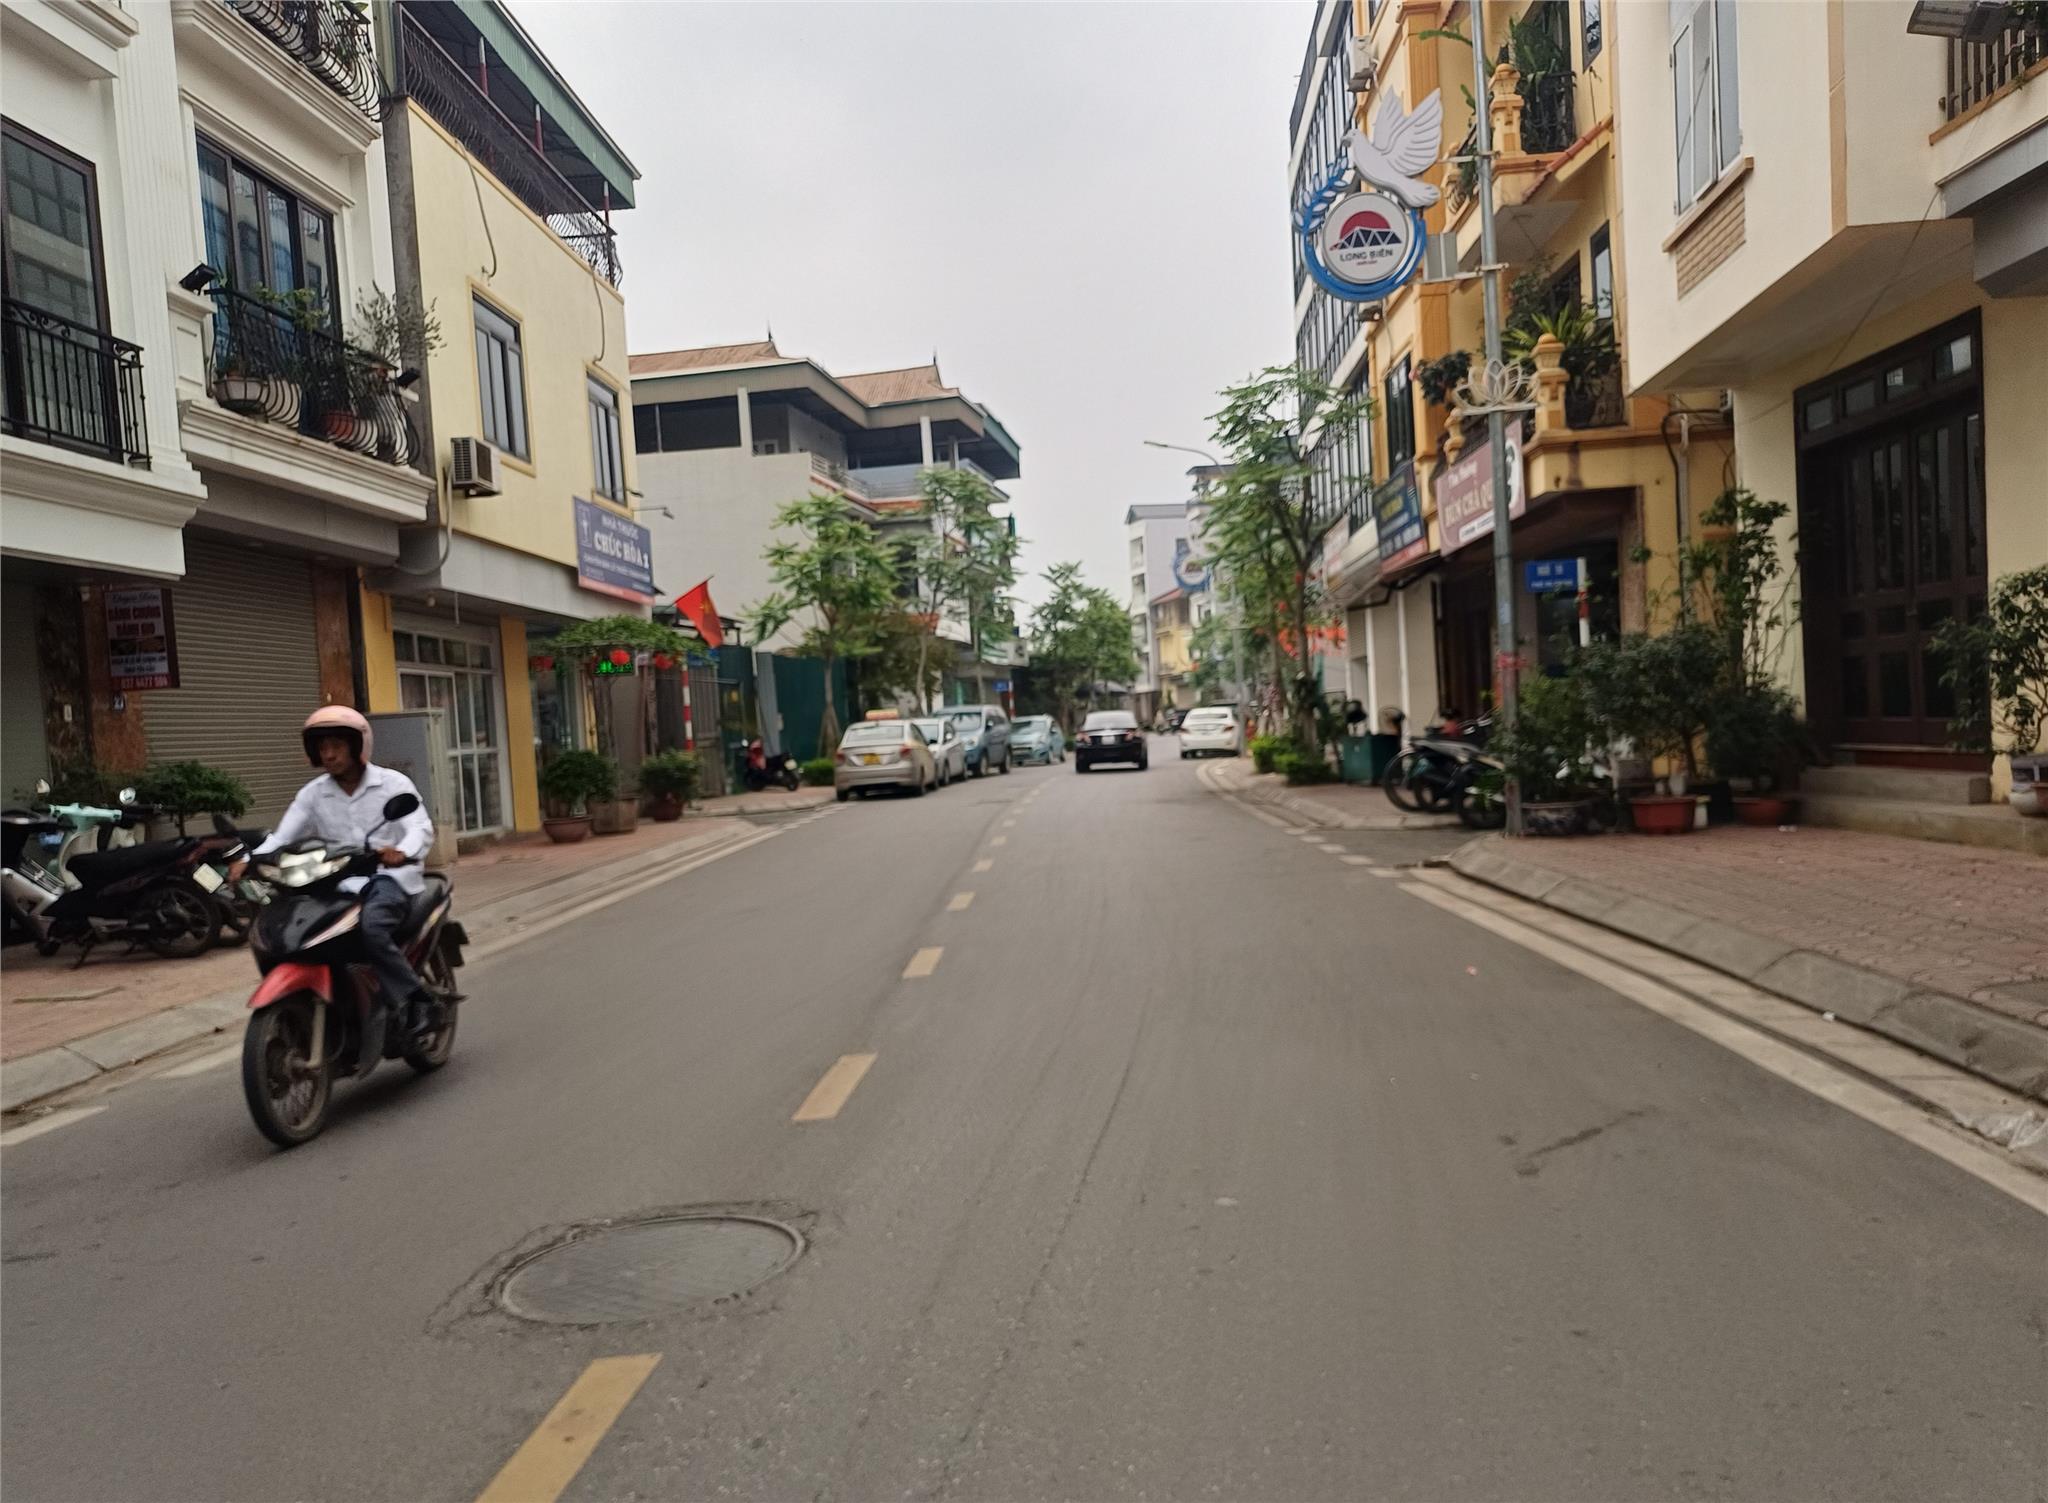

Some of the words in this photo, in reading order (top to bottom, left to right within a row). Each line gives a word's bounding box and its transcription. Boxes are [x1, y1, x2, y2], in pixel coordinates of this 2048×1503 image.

[1340, 251, 1367, 262] LONG
[594, 530, 623, 559] CHÚC
[623, 539, 643, 566] HÒA
[643, 553, 650, 569] 1
